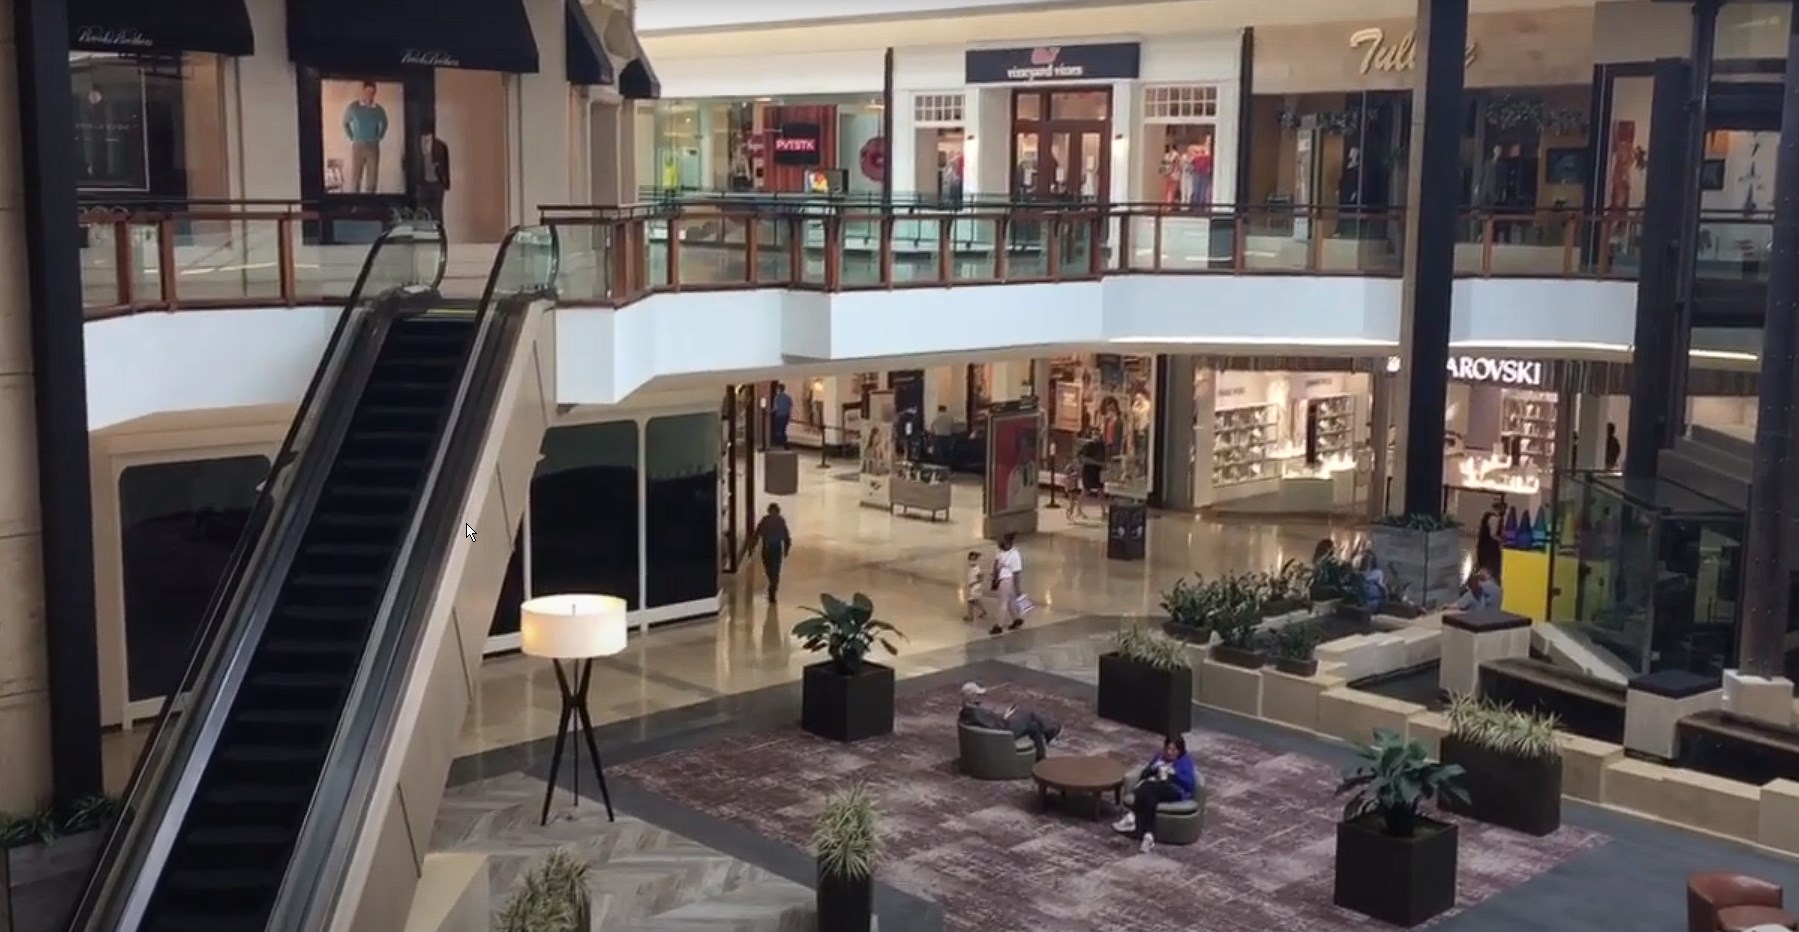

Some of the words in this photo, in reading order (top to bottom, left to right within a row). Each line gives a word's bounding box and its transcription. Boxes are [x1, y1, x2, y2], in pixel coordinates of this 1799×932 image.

[1007, 64, 1053, 81] vineyard
[1055, 63, 1083, 76] vines
[1447, 356, 1541, 386] AROVSKI
